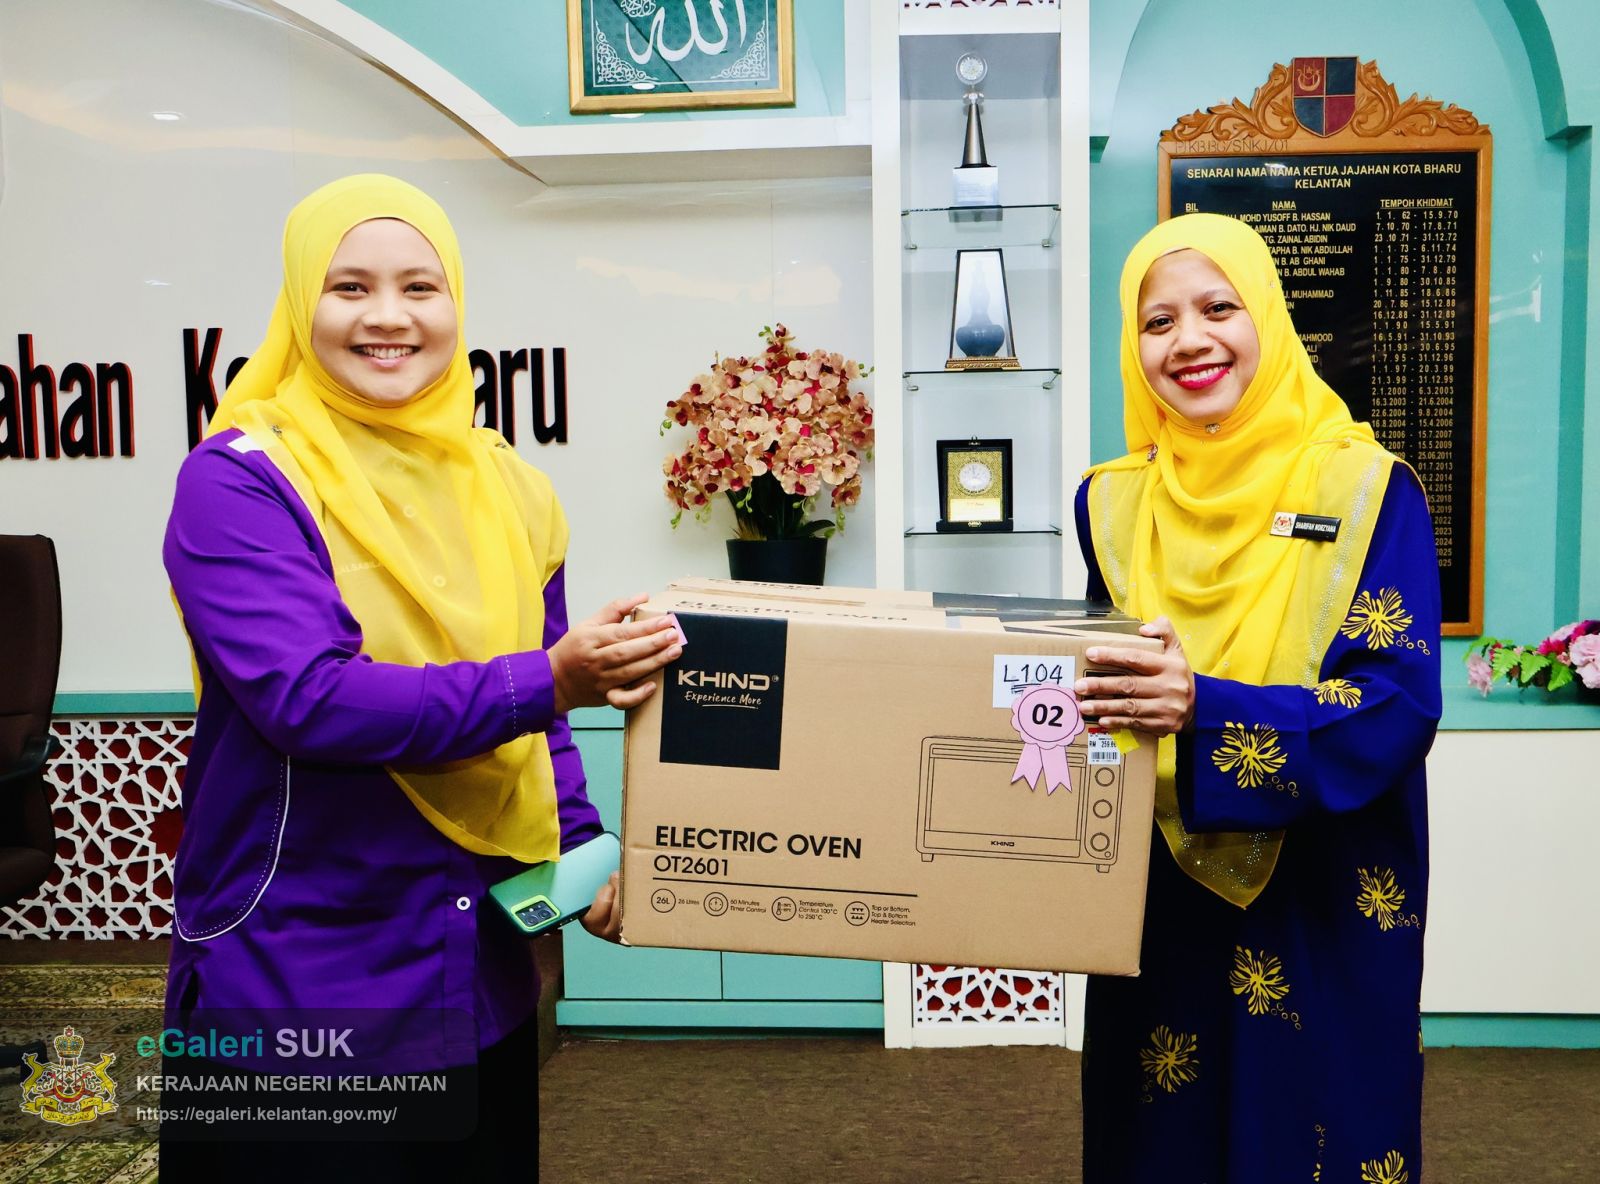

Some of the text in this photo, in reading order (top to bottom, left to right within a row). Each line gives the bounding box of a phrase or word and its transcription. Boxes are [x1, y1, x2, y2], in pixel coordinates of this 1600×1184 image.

[1187, 163, 1461, 179] SENARAI NAMA NAMA KETUA JAJAHAN KOTA BHARU
[1295, 179, 1351, 189] KELANTAN
[1186, 198, 1453, 211] BIL NAMA TEMPOH KHIDMAT
[1263, 213, 1290, 222] YUSOFF
[1301, 213, 1331, 221] HASSAN
[1252, 224, 1277, 233] AIMAN
[1322, 224, 1334, 232] NIK
[1336, 224, 1356, 232] DAUD
[1278, 235, 1302, 244] ZAINAL
[1304, 235, 1328, 243] ABIDIN
[1300, 246, 1312, 254] NIK
[1314, 246, 1353, 254] ABDULLAH
[1290, 257, 1300, 265] AB
[1303, 257, 1326, 265] GHANI
[1293, 268, 1316, 276] ABDUL
[1318, 268, 1344, 276] WAHAB
[1292, 290, 1334, 298] MUHAMMAD
[0, 333, 135, 459] ahan
[468, 347, 568, 447] aru
[1375, 430, 1406, 438] 6.4.2006
[1424, 484, 1452, 492] .4.2015
[1003, 664, 1063, 685] L104
[678, 670, 770, 691] KHIND
[684, 690, 762, 706] Experience More
[1032, 704, 1064, 728] 02
[656, 826, 862, 858] ELECTRIC OVEN
[654, 855, 728, 876] OT2601
[656, 896, 670, 904] 26L
